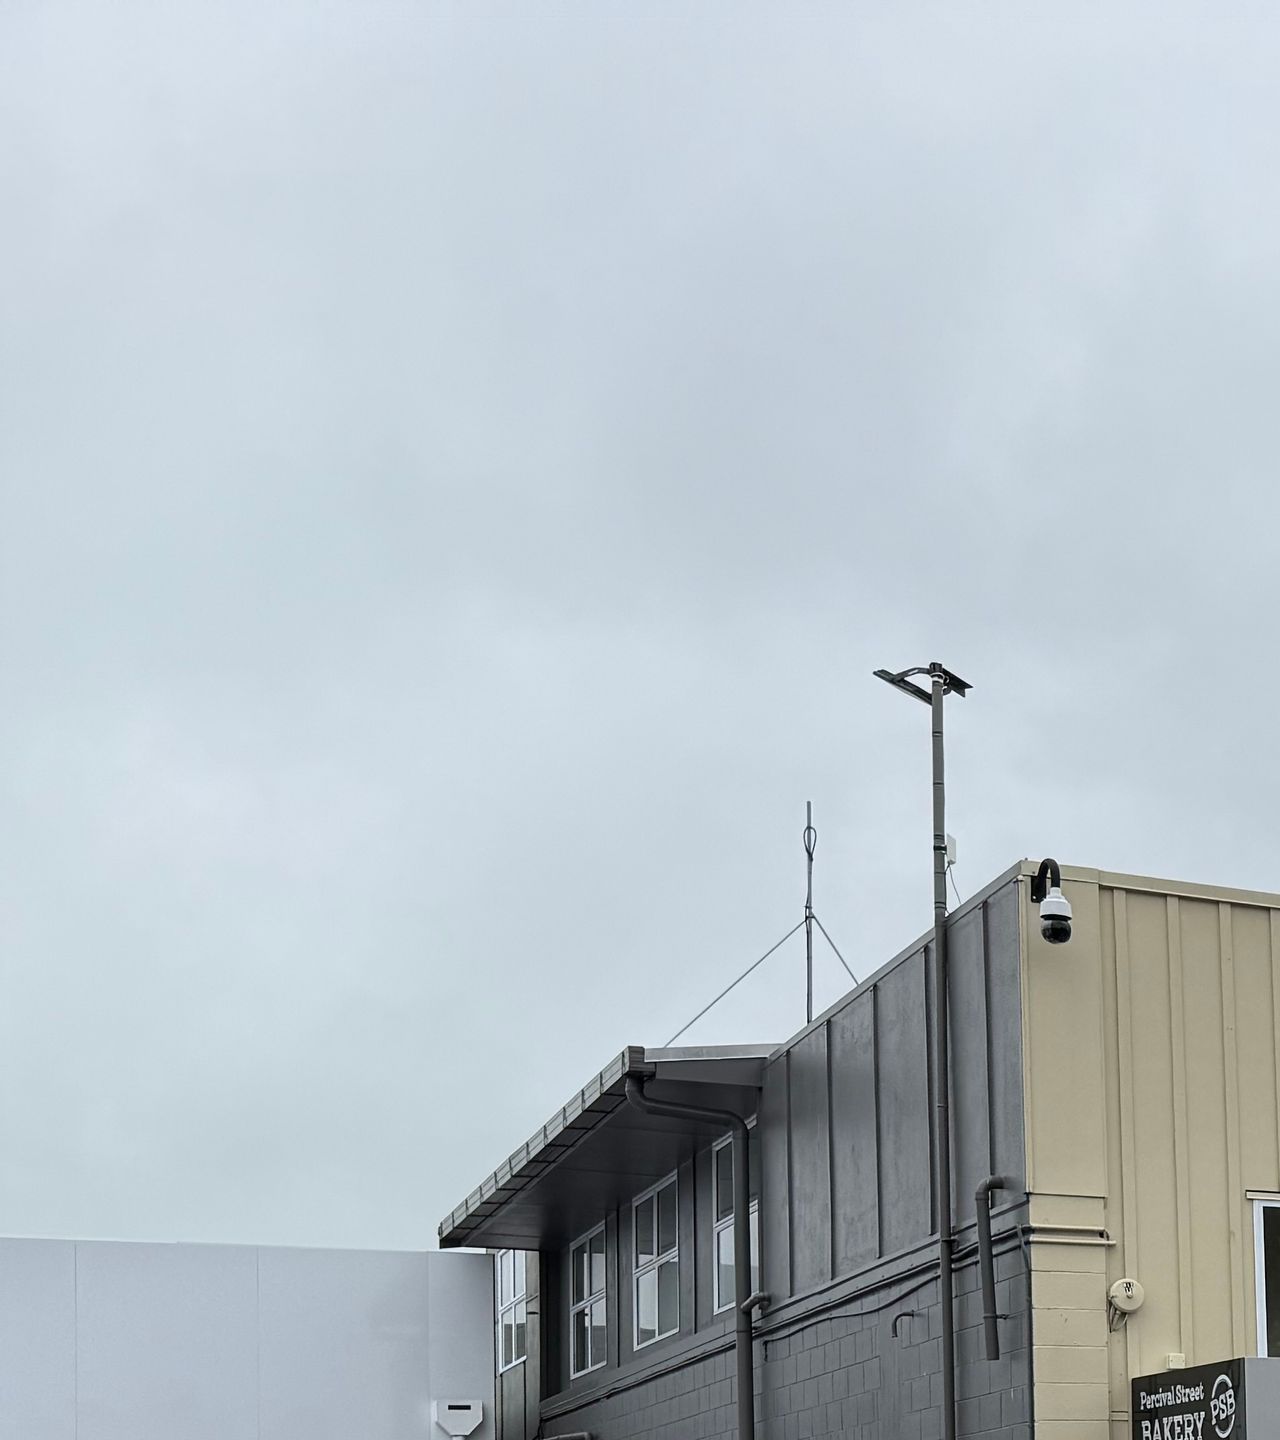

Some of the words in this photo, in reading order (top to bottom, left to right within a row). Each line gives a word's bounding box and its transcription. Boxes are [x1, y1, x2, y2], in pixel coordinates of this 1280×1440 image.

[1140, 1385, 1176, 1410] Percival
[1176, 1382, 1205, 1403] Street
[1210, 1388, 1236, 1426] PSB
